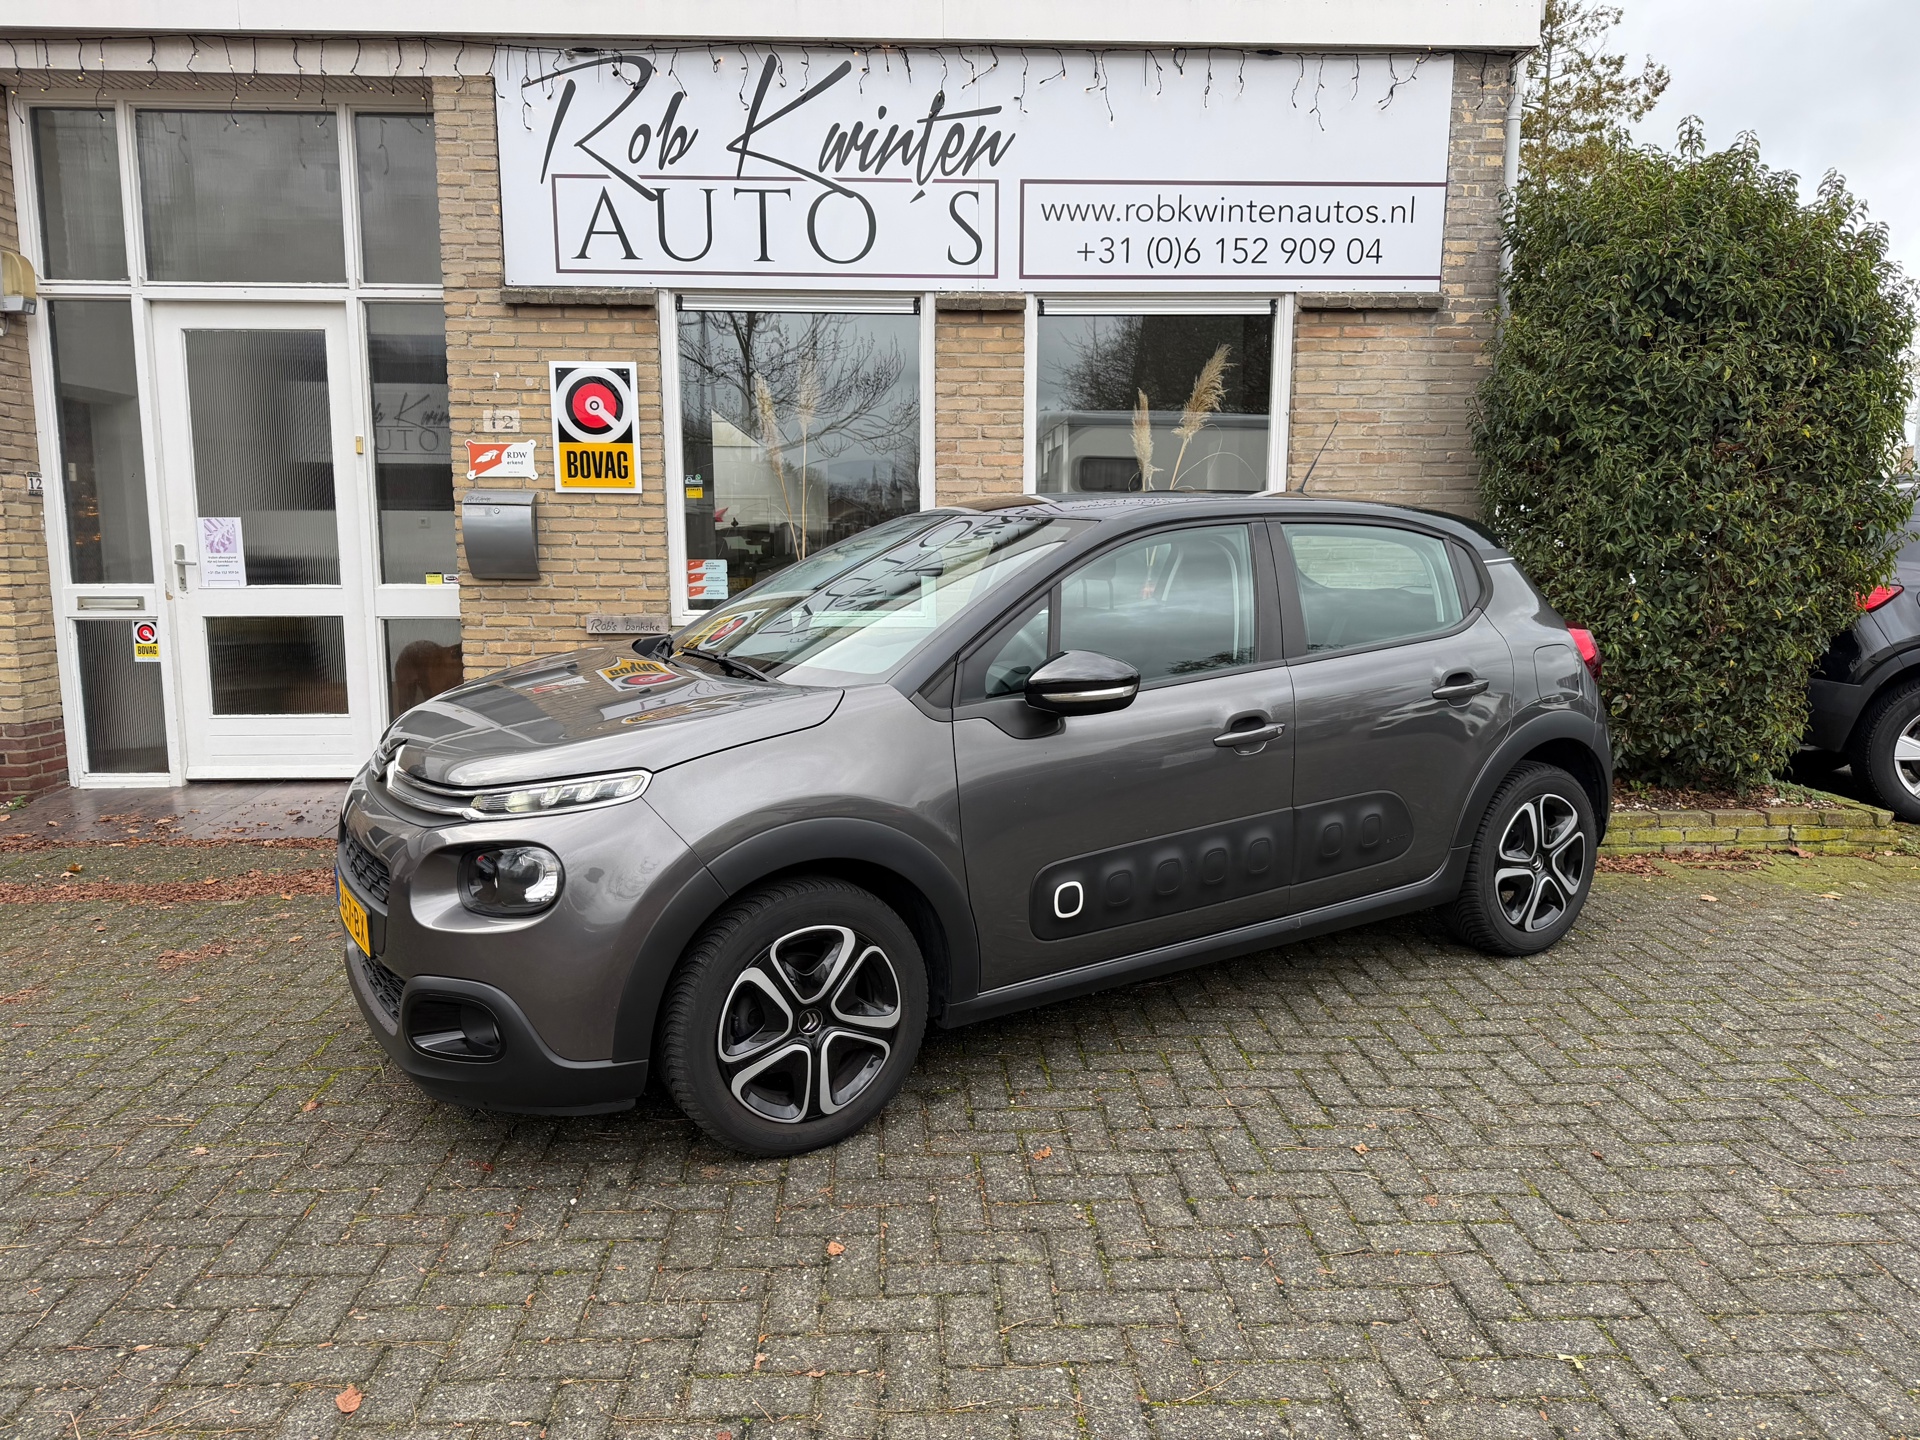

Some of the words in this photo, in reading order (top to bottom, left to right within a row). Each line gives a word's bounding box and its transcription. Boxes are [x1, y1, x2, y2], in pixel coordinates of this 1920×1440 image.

[522, 55, 698, 201] Rob
[727, 54, 1016, 198] Kwinten
[1040, 194, 1416, 224] www.robkwintenautos.nl
[1077, 237, 1131, 264] +31
[1146, 236, 1201, 269] (0)6
[1216, 237, 1268, 264] 152
[1281, 237, 1335, 264] 909
[1347, 238, 1383, 265] 04
[506, 451, 527, 459] RDW
[567, 450, 629, 479] BOVAG
[29, 477, 43, 490] 12
[590, 618, 618, 632] Rob's
[137, 645, 157, 655] BOVAG
